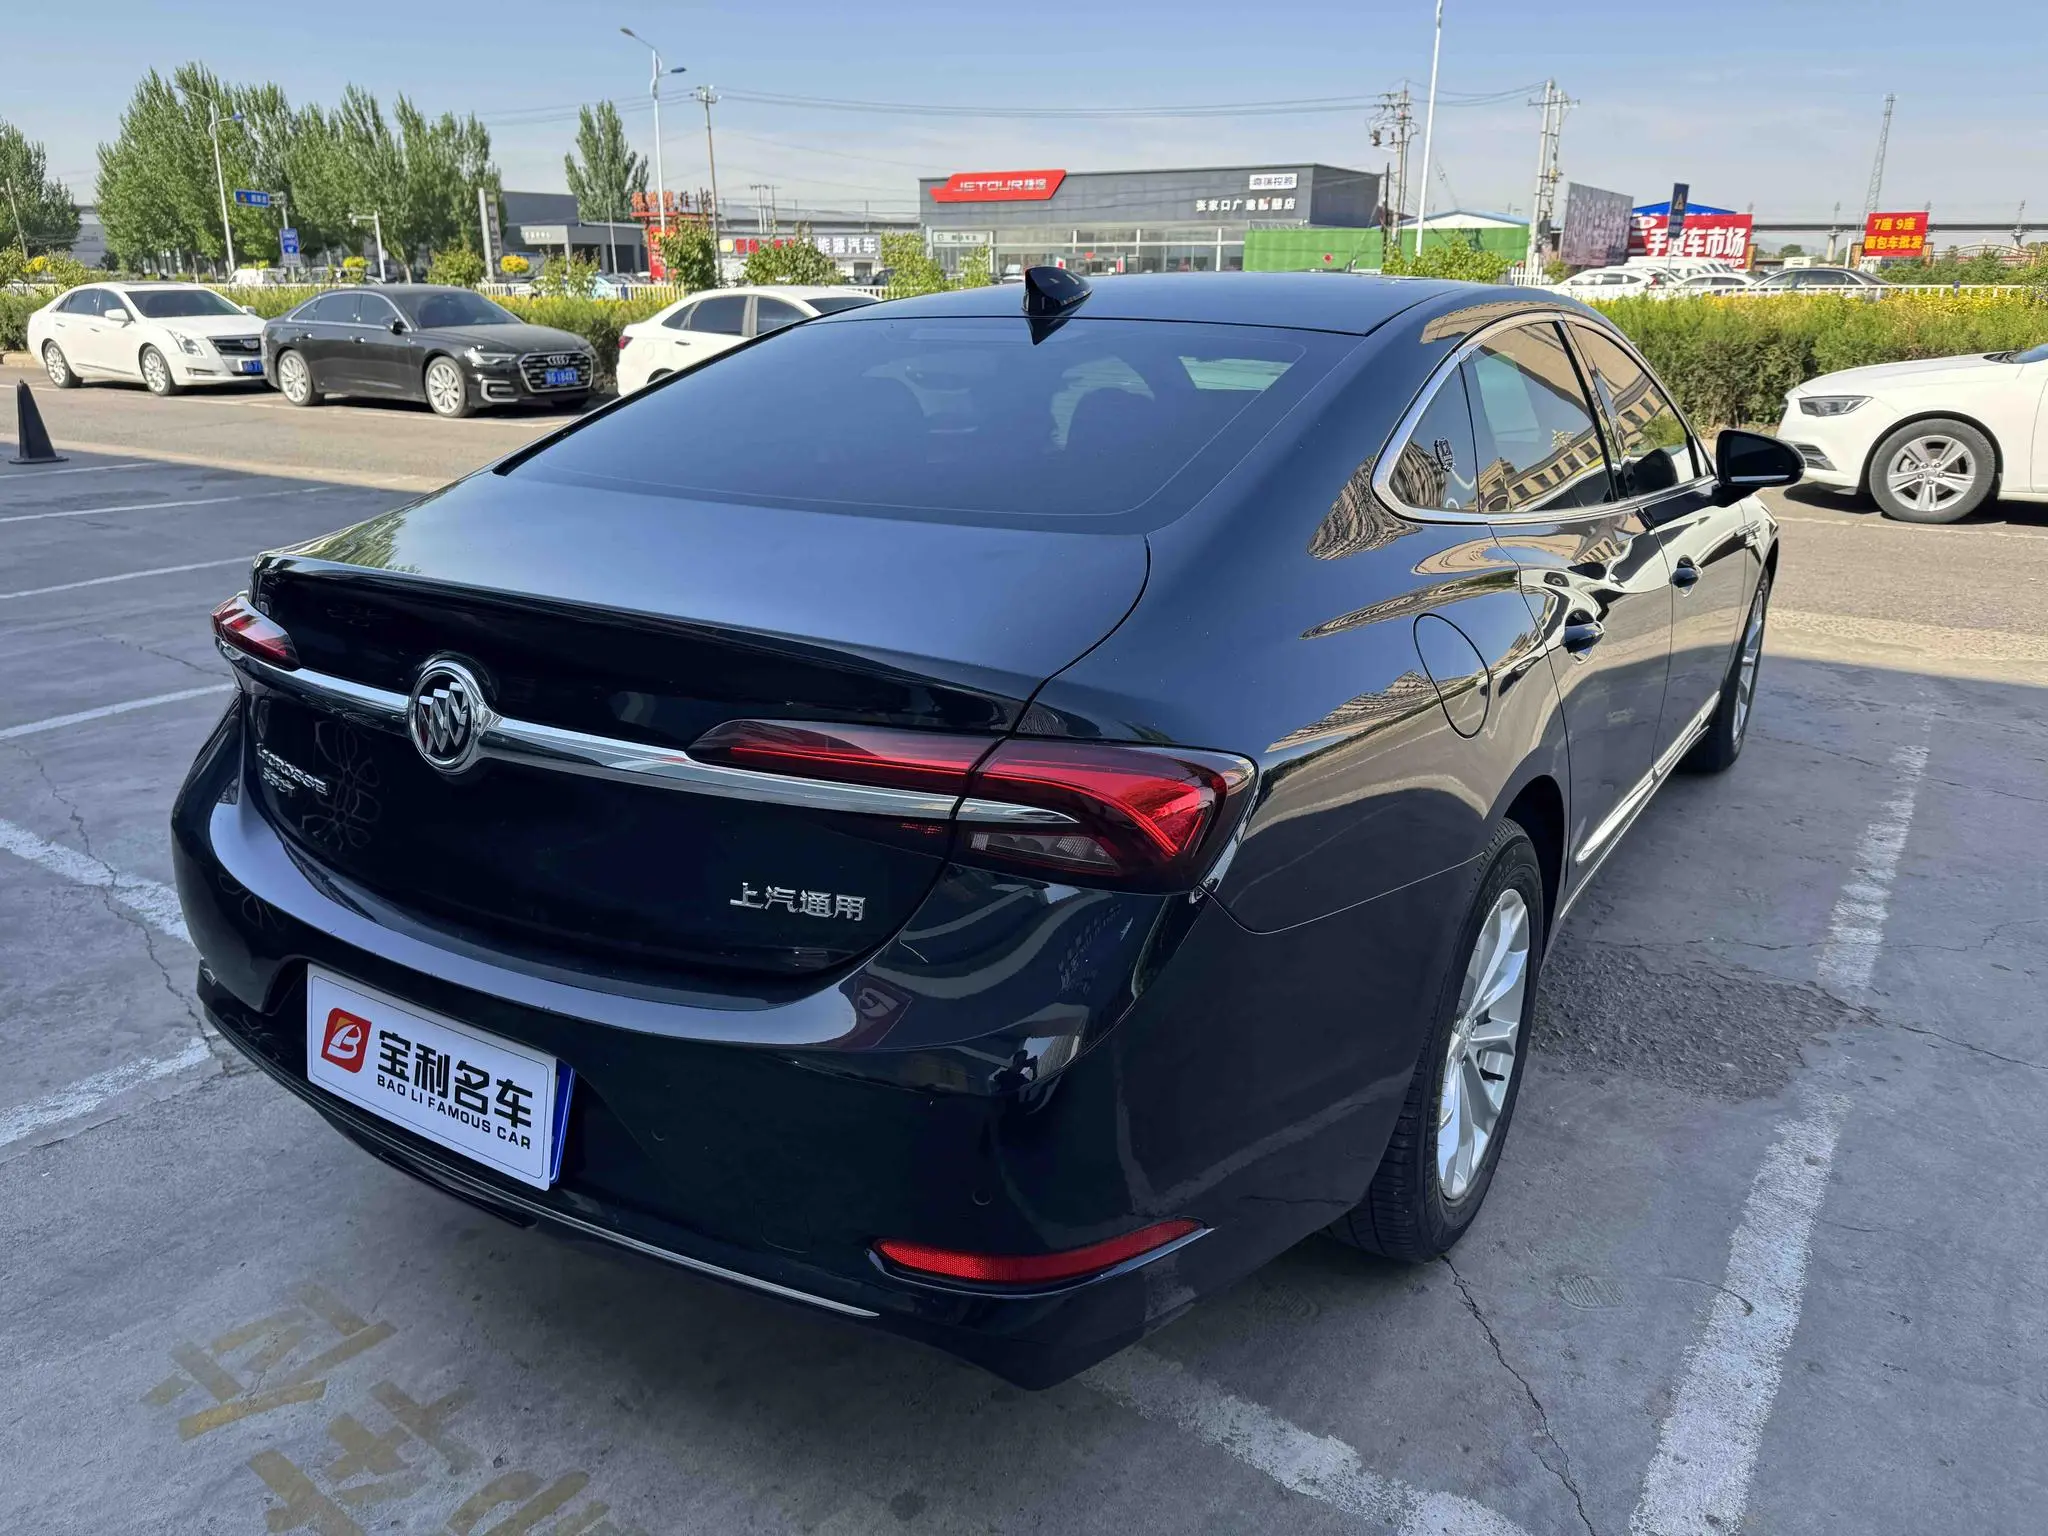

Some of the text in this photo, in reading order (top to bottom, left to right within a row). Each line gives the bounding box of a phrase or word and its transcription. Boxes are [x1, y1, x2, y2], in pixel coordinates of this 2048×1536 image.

[954, 180, 1022, 192] JETOUR
[1874, 216, 1916, 231] 7座 9座
[804, 237, 876, 254] 能源汽车
[1864, 235, 1923, 250] 面包车批发
[729, 882, 866, 921] 上汽通用
[377, 1029, 533, 1129] 宝利名车
[377, 1073, 532, 1150] BAO LI FAMOUS CAR
